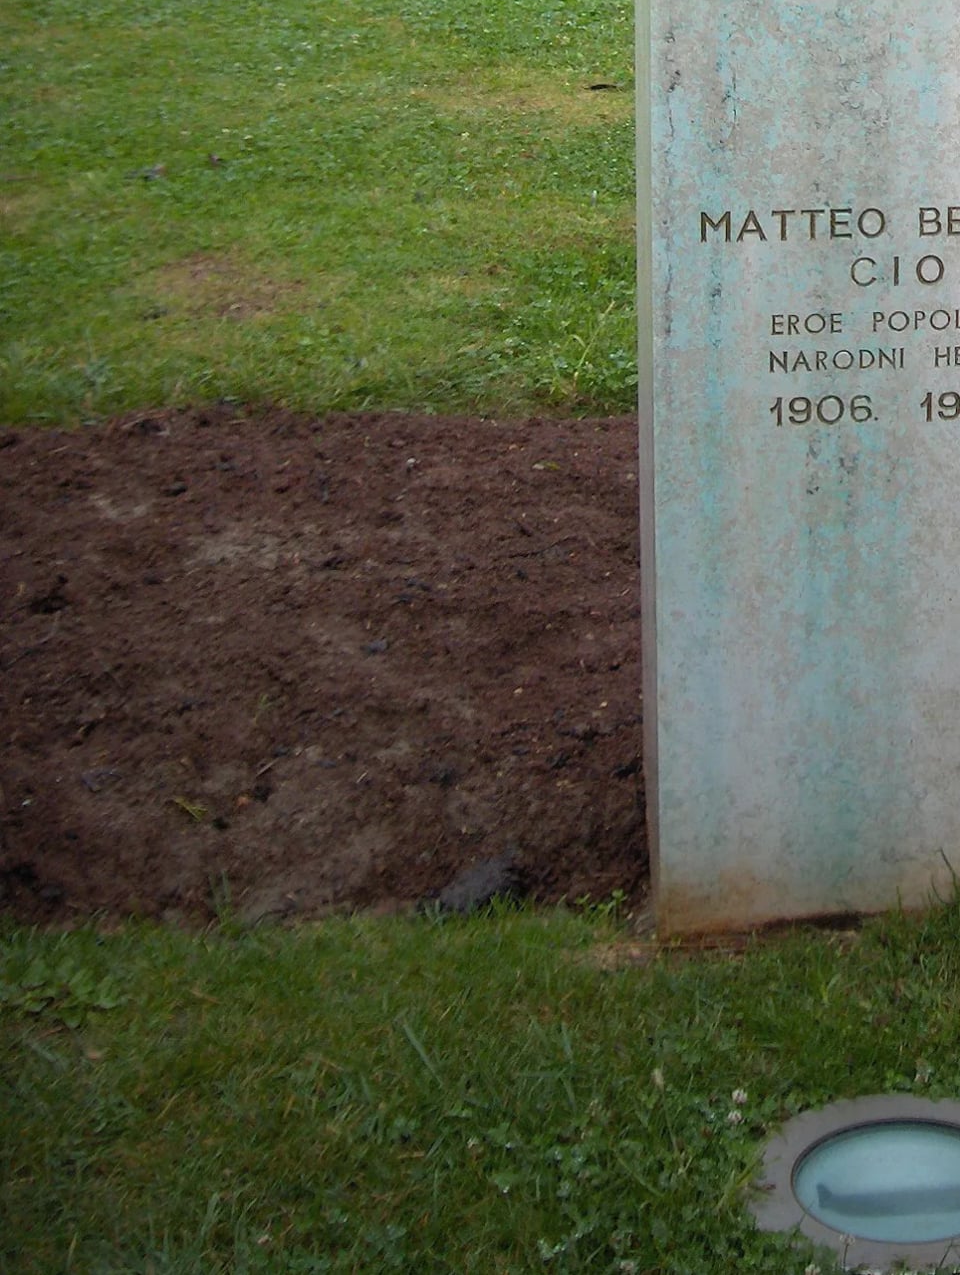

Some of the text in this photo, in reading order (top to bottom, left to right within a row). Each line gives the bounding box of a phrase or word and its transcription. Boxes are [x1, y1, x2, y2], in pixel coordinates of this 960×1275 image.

[700, 207, 886, 243] MATTEO
[770, 312, 843, 336] EROE
[768, 347, 906, 374] NARODNI
[769, 394, 879, 427] 1906.
